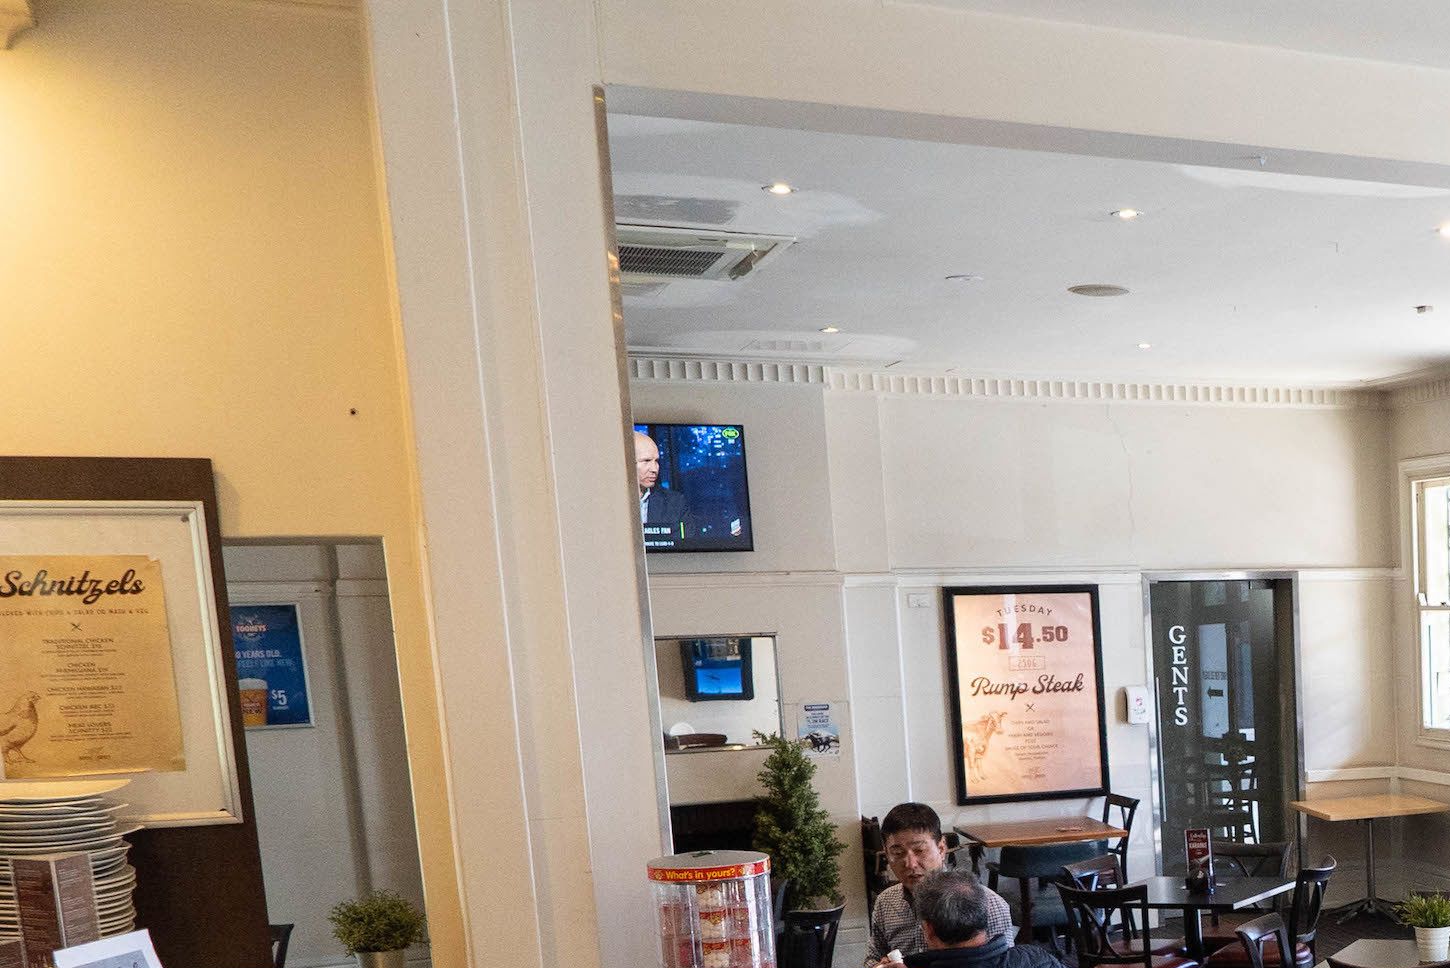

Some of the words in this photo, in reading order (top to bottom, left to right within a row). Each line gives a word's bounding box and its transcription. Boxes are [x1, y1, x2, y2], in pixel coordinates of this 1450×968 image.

[0, 568, 146, 605] Schnitzels
[997, 604, 1053, 616] TUESDAY
[982, 623, 1069, 650] $14.50
[242, 650, 265, 658] YEARS
[1168, 625, 1189, 726] GENTS
[271, 689, 287, 705] $5
[970, 676, 1029, 701] Rump
[1032, 672, 1085, 695] Steak
[665, 870, 693, 879] What's
[694, 870, 704, 879] in
[706, 868, 735, 880] yours?
